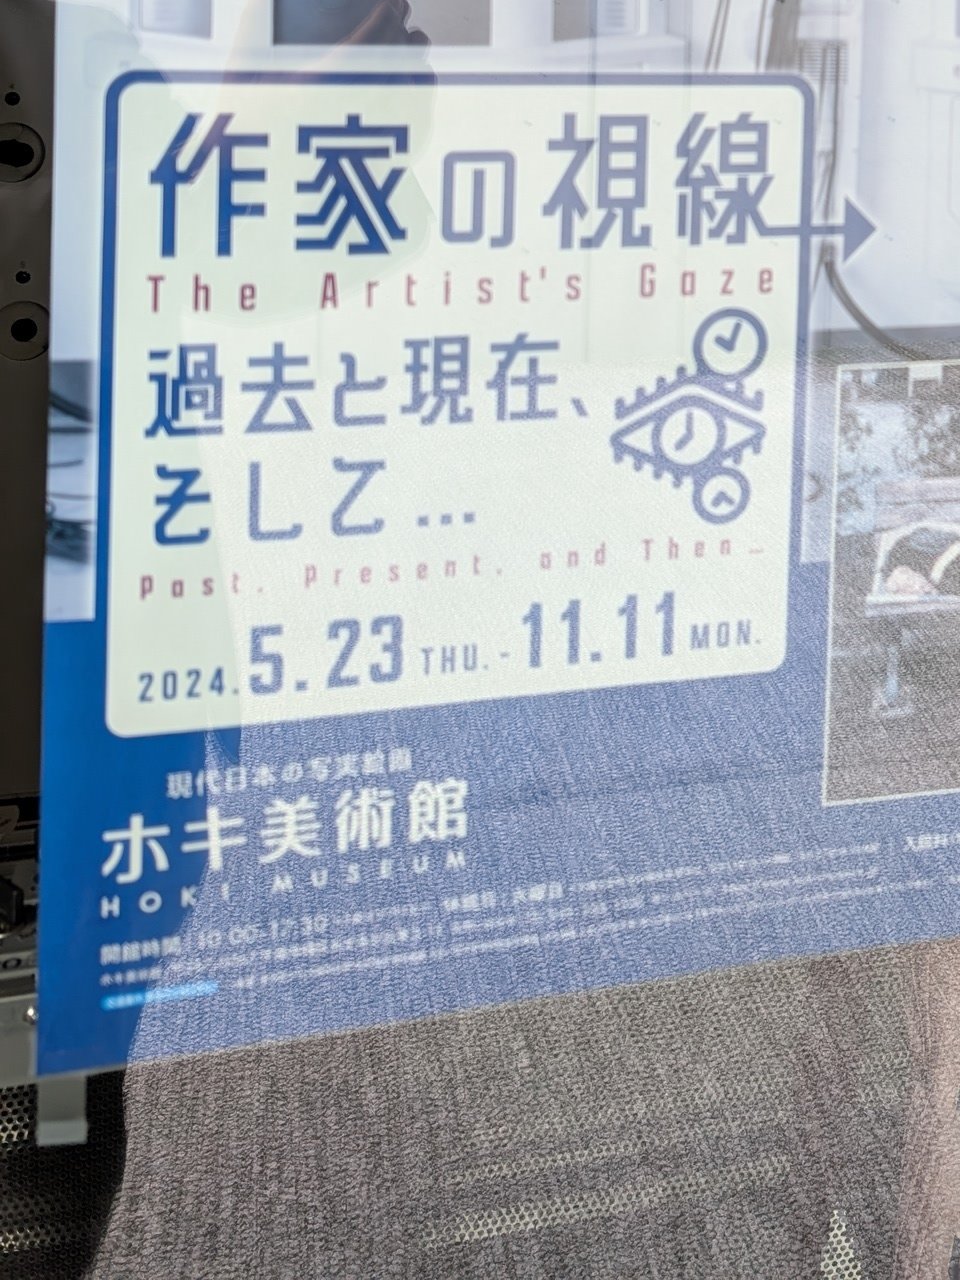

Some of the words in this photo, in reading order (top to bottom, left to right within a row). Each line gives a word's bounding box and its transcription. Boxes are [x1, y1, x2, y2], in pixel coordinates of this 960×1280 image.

[150, 112, 782, 258] 作家の視線
[146, 274, 257, 314] The
[320, 266, 582, 309] Artist's
[639, 262, 775, 299] Gaze
[145, 333, 590, 438] 過去と現在、
[541, 544, 606, 571] and
[522, 592, 676, 669] 11.11
[690, 622, 761, 650] MON.
[102, 780, 469, 883] ホキ美術館
[101, 882, 233, 917] HOKI
